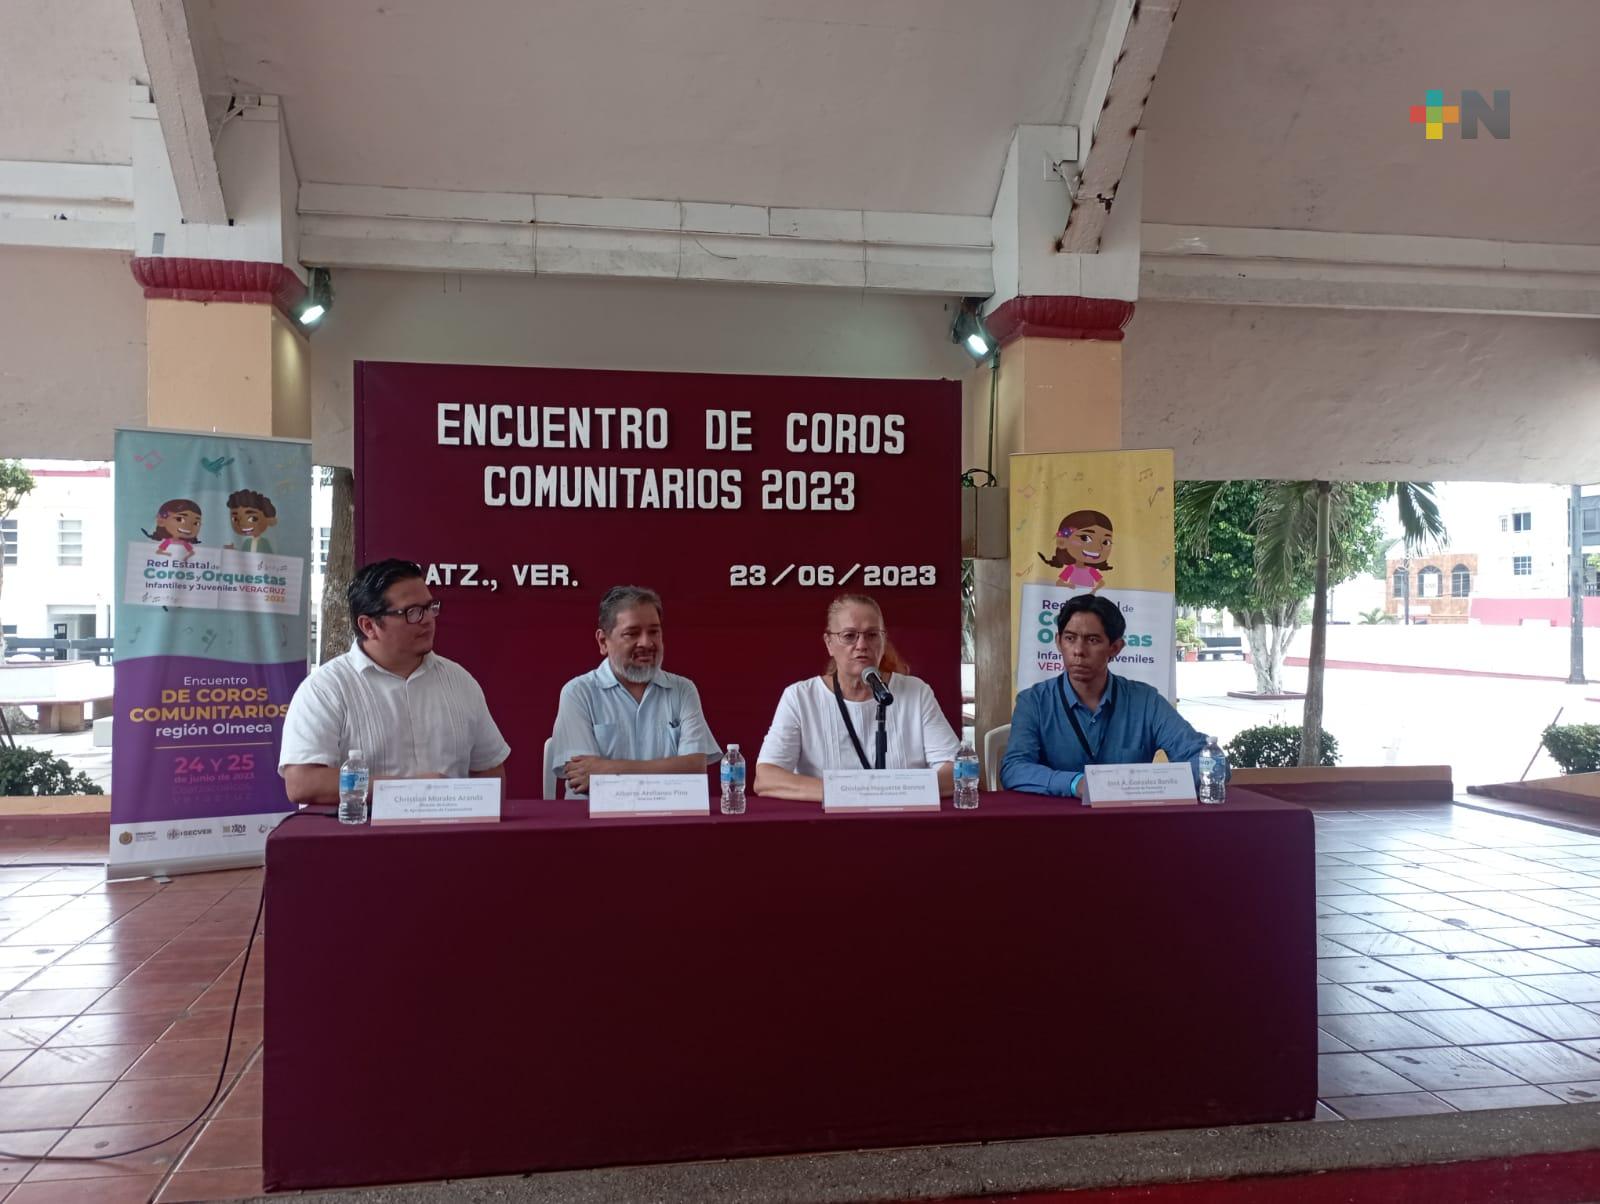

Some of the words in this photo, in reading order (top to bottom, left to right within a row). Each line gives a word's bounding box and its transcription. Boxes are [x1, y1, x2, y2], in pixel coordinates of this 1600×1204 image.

[437, 403, 669, 449] ENCUENTRO
[705, 409, 753, 451] DE
[786, 412, 905, 454] COROS
[484, 465, 742, 510] COMUNITARIOS
[761, 469, 856, 511] 2023
[146, 559, 169, 568] Red
[172, 559, 210, 569] Estatal
[143, 567, 196, 580] Coros
[202, 570, 287, 586] Orquestas
[416, 563, 498, 592] ATZ.,
[512, 563, 579, 587] VER.
[145, 581, 188, 591] Infantiles
[196, 583, 238, 592] Juveniles
[238, 585, 287, 595] VERACRUZ
[1121, 604, 1134, 612] de
[183, 676, 249, 686] Encuentro
[161, 689, 191, 704] DE
[196, 687, 269, 703] COROS
[155, 724, 208, 739] región
[212, 722, 273, 735] Olmeca
[174, 756, 205, 774] 24
[227, 753, 256, 771] 25
[174, 775, 187, 783] de
[189, 773, 216, 784] junio
[218, 772, 231, 781] de
[428, 793, 456, 802] Morales
